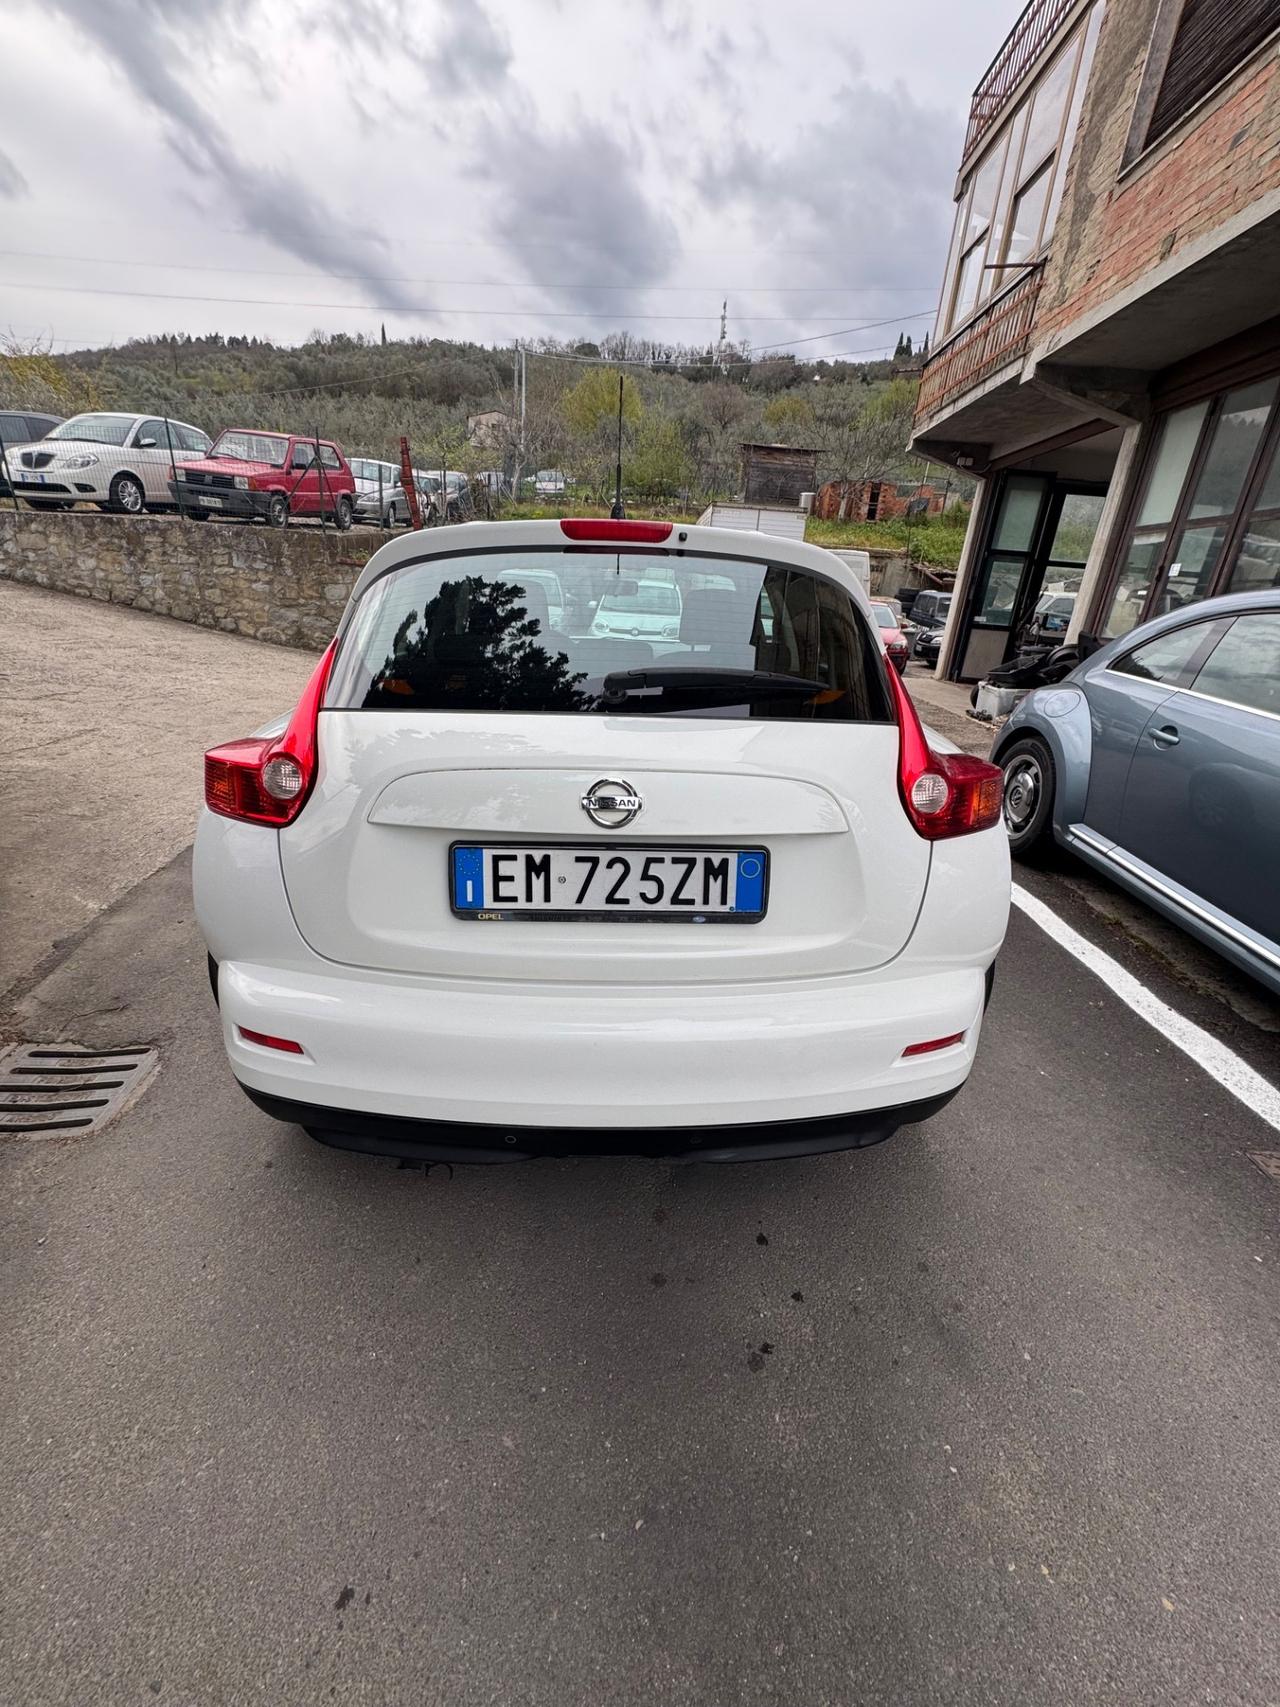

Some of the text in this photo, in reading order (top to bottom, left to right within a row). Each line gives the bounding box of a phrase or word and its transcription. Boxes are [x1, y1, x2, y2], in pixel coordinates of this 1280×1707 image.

[588, 799, 636, 808] NISSAN
[492, 854, 729, 906] EM 725ZM
